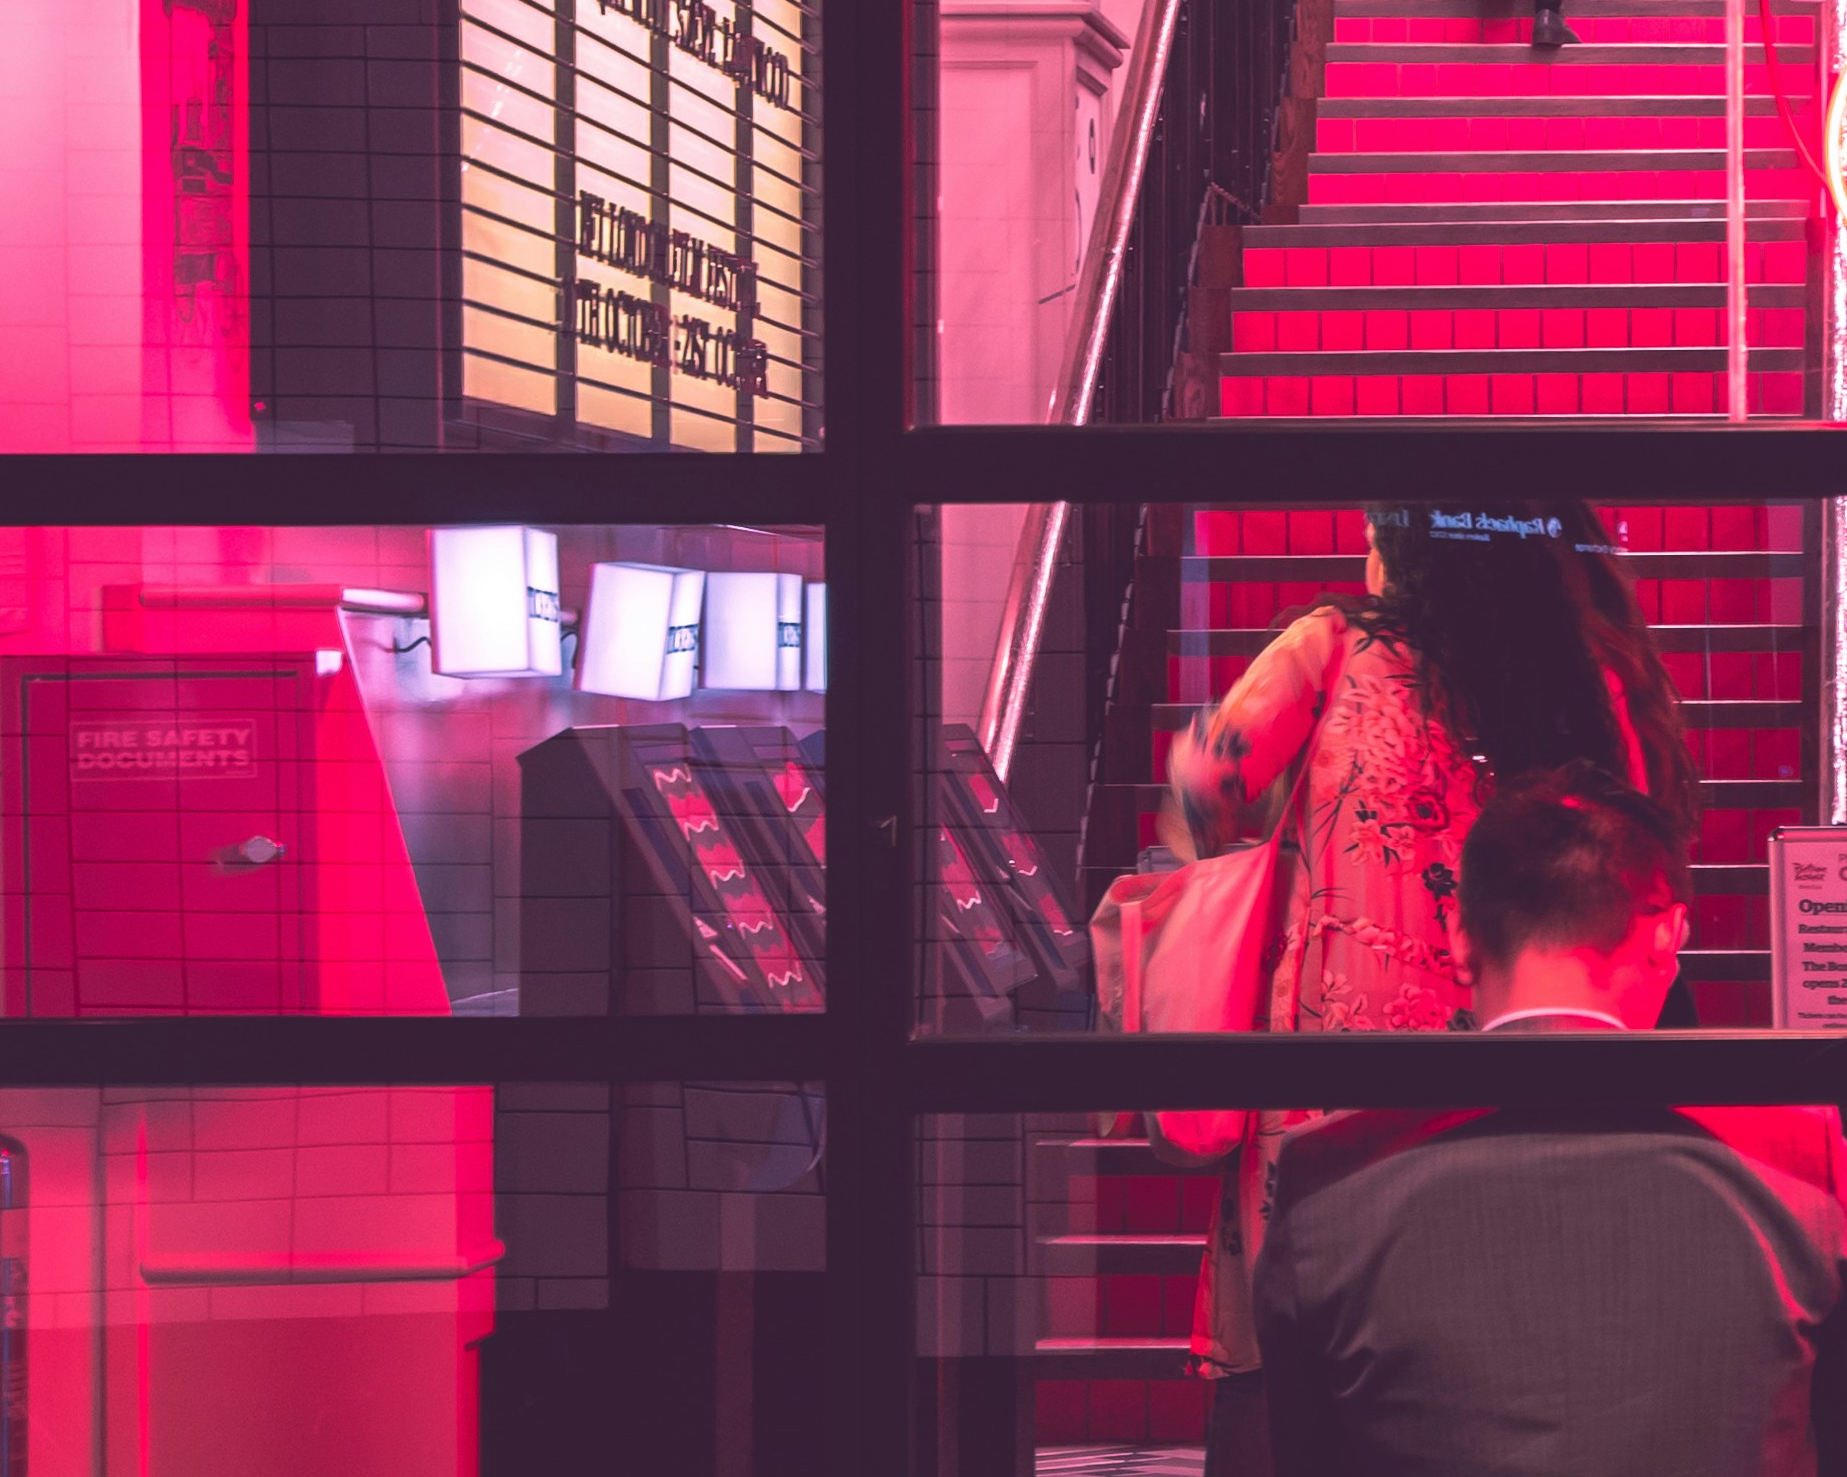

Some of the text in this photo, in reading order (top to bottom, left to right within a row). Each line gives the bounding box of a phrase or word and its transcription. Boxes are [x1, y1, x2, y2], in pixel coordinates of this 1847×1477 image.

[77, 728, 251, 749] FIRE SAFETY
[77, 749, 251, 770] DOCUMENTS
[1801, 961, 1826, 972] The
[1802, 980, 1840, 990] opens
[1827, 995, 1847, 1005] the
